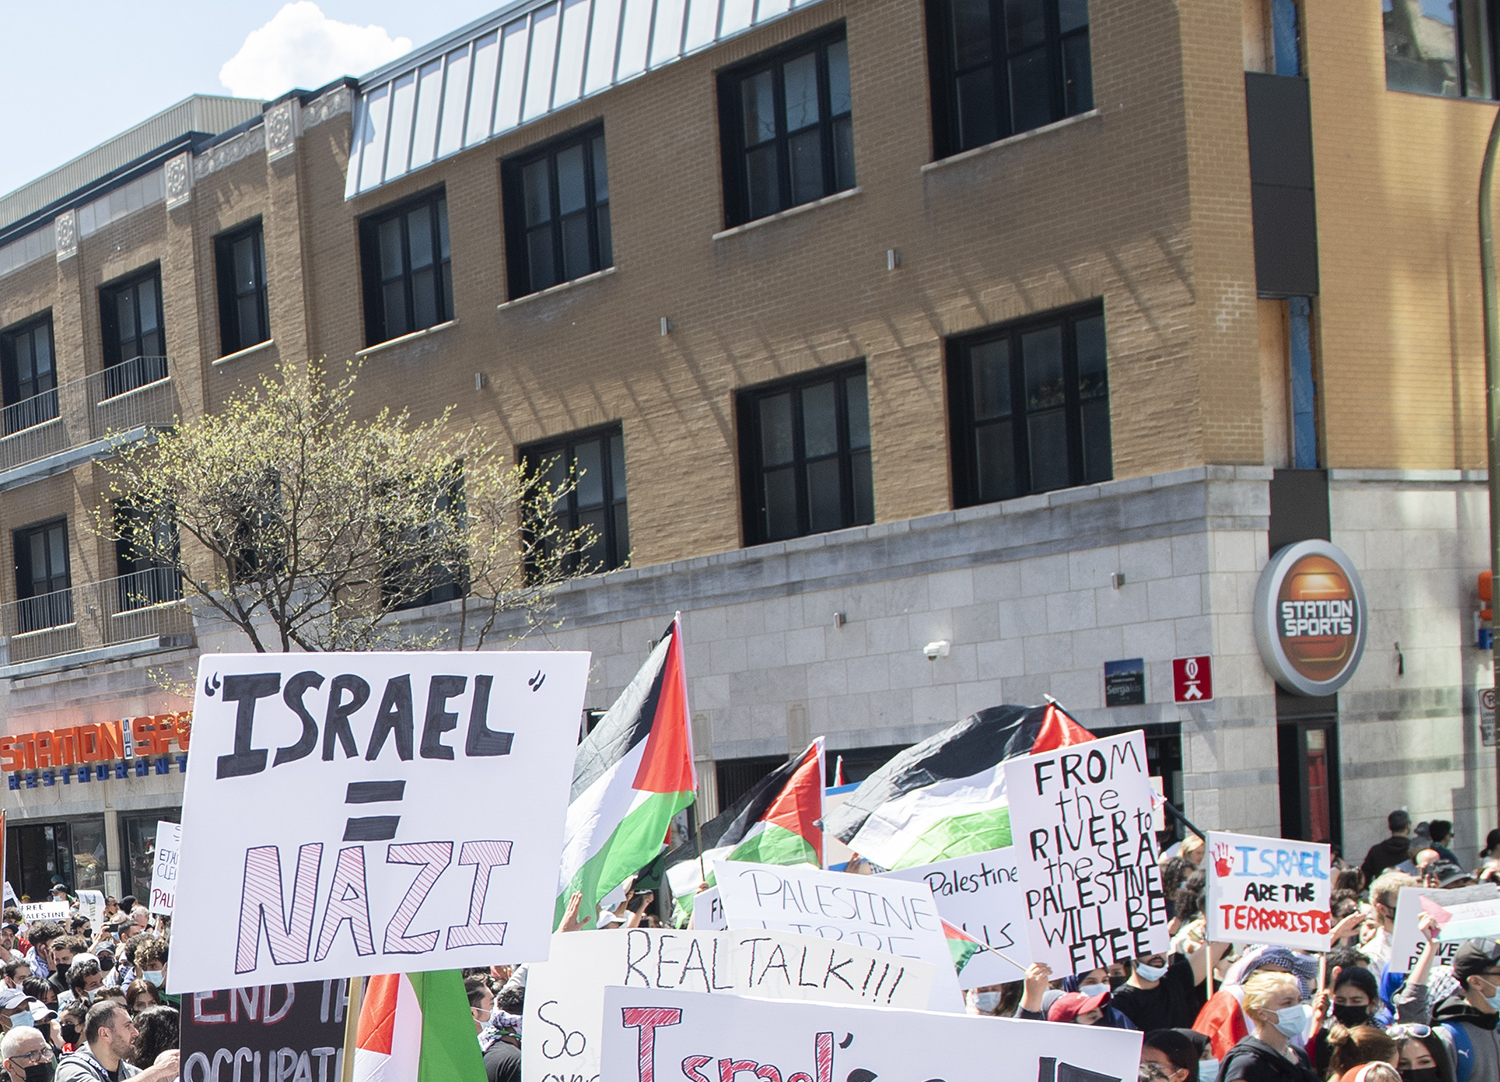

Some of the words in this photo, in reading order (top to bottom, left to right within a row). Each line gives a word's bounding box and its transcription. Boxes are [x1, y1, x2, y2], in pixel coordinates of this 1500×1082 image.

[1282, 600, 1353, 618] STATION
[1285, 618, 1352, 636] SPORTS
[0, 720, 124, 772] STATION
[123, 719, 133, 758] DES
[132, 712, 194, 756] SPO
[1034, 741, 1142, 796] FROM
[8, 756, 188, 791] RESTAURANT
[1055, 787, 1120, 824] the
[1029, 811, 1129, 861] RIVER
[1133, 807, 1153, 835] to
[1043, 857, 1093, 886] the
[1098, 833, 1159, 875] SEA
[923, 862, 1019, 897] Palestine
[1234, 846, 1329, 880] ISRAEL
[235, 840, 513, 975] NAZI
[739, 869, 937, 932] PALESTINE
[1026, 865, 1165, 920] PALESTINE
[1244, 882, 1279, 903] ARE
[1281, 882, 1315, 903] THE
[1039, 904, 1127, 949] WILL
[1125, 892, 1166, 932] BE
[1219, 904, 1331, 935] TERRORISTS
[625, 929, 732, 994] REAL
[739, 936, 904, 1004] TALK!!!
[1068, 926, 1152, 979] FREE
[1415, 941, 1460, 957] SVE
[191, 982, 295, 1024] END
[538, 1001, 586, 1059] So
